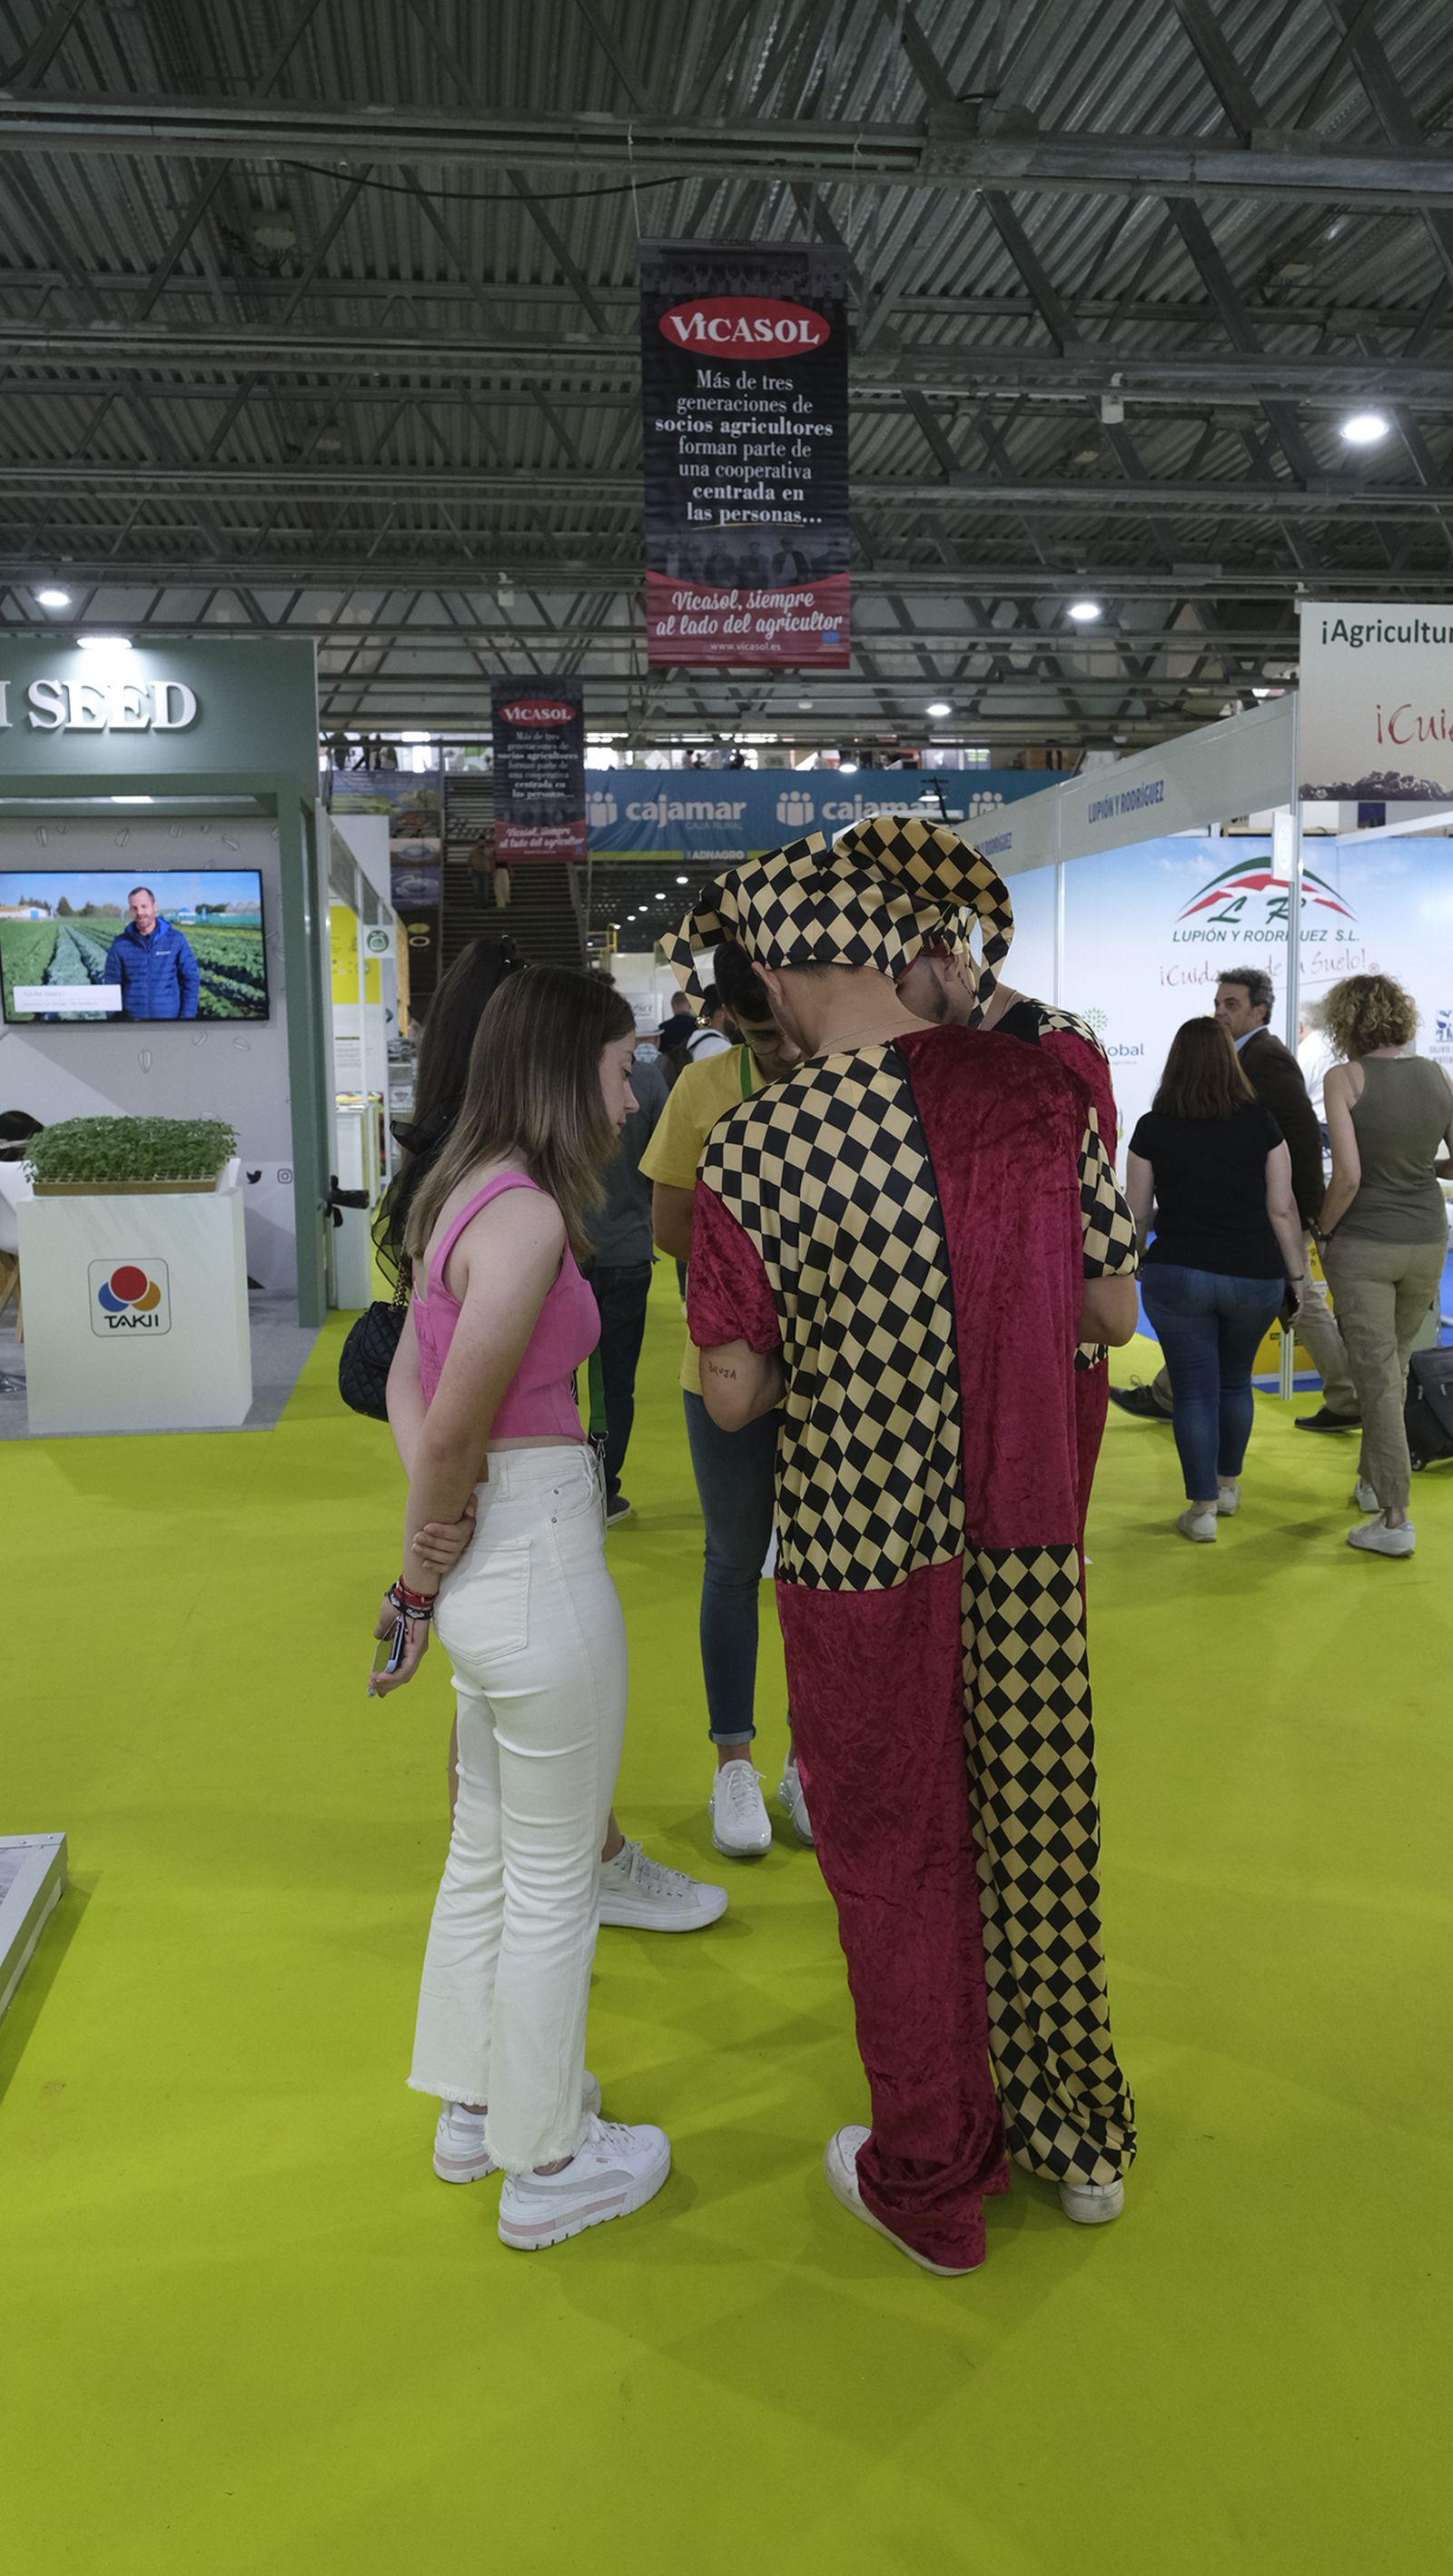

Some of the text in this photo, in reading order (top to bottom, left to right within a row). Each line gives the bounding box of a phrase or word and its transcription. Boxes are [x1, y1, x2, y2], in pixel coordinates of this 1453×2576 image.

[697, 370, 794, 390] Más de tres
[677, 393, 813, 415] generaciones de
[655, 415, 834, 439] socios agricultores
[678, 435, 812, 461] forman parte de
[678, 461, 813, 483] una cooperativa
[692, 481, 805, 501] centrada en
[687, 502, 823, 526] las personas...
[672, 588, 815, 614] Vicasol, siempre
[656, 610, 843, 639] al lado del agricultor
[709, 641, 782, 652] www.vicasol.es
[28, 679, 197, 729] SEED
[1376, 703, 1453, 745] ¡Cui
[625, 794, 747, 828] cajamar
[685, 821, 744, 831] CAJA RURAL
[1172, 927, 1227, 942] LUPIÓN
[1231, 930, 1241, 942] Y
[1335, 929, 1360, 943] S.L.
[1310, 947, 1366, 975] Suelo!
[1108, 1042, 1145, 1056] obal
[104, 1314, 159, 1328] TAKII
